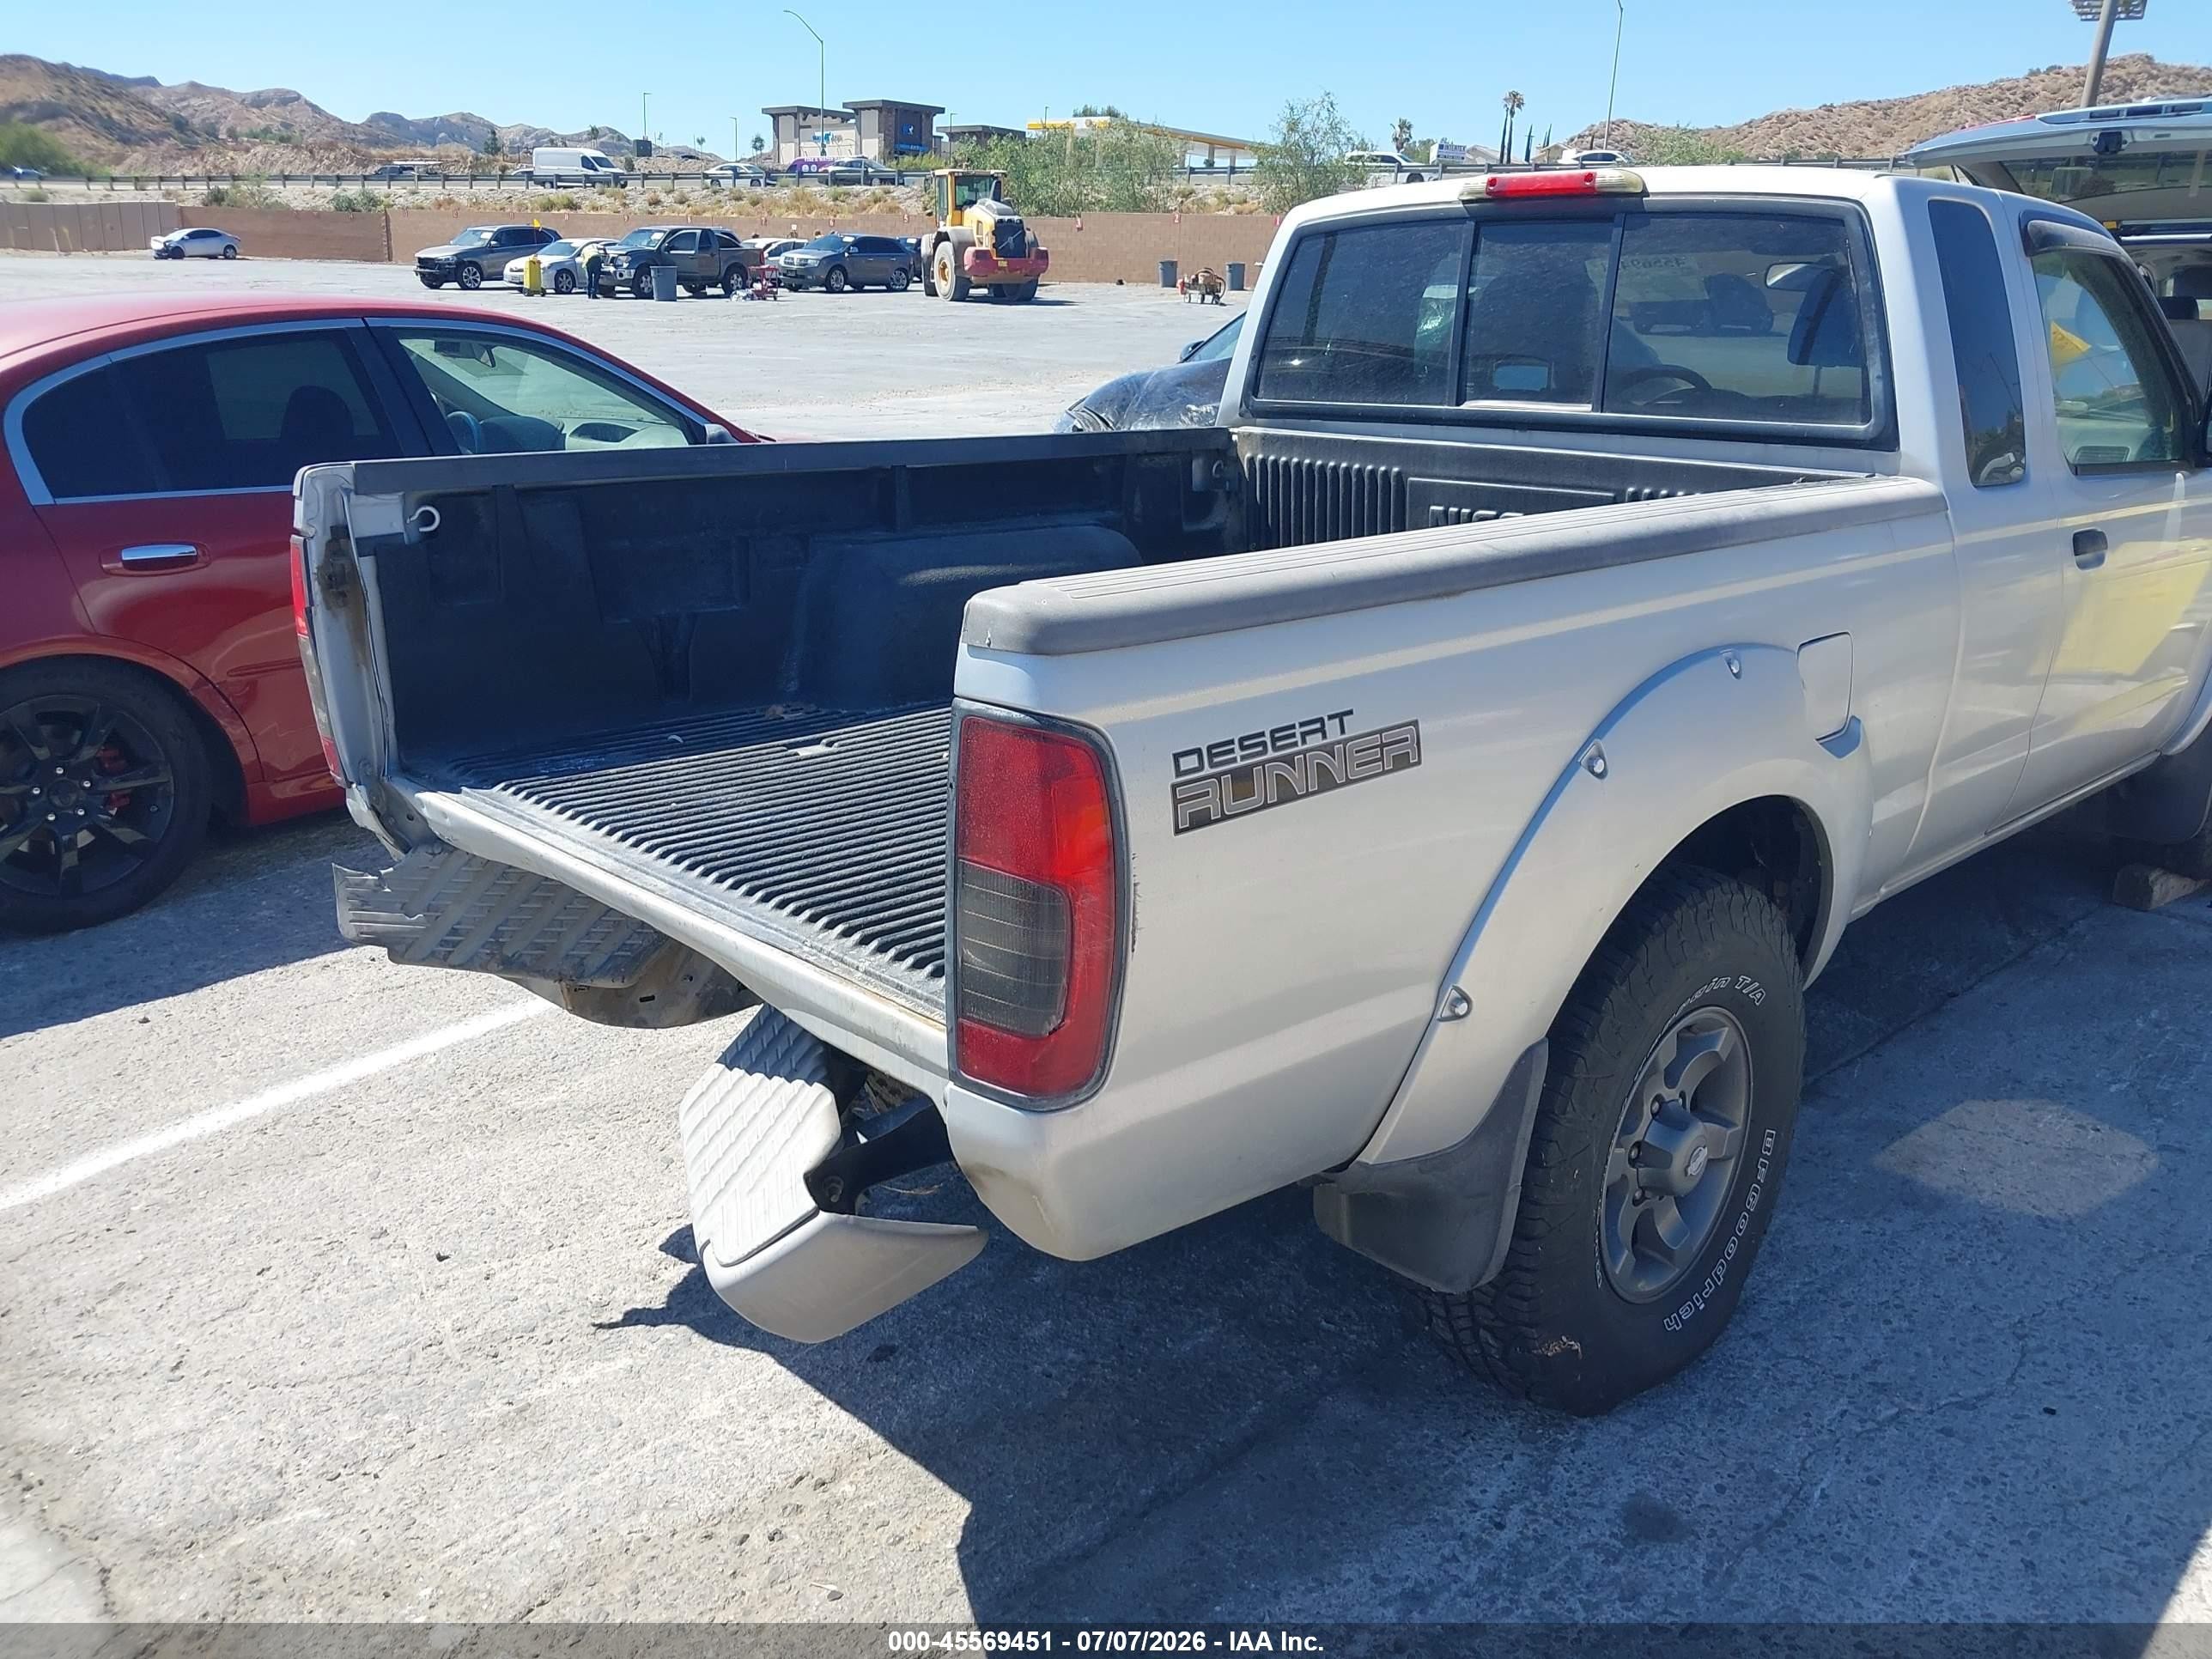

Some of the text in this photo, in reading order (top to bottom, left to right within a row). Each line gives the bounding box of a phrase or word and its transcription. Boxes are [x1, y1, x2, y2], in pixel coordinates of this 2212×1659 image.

[1172, 708, 1355, 778] DESERT
[1175, 725, 1419, 830] RUNNER
[1735, 975, 1766, 1006] T/A
[1662, 1127, 1776, 1333] BFGoodrich
